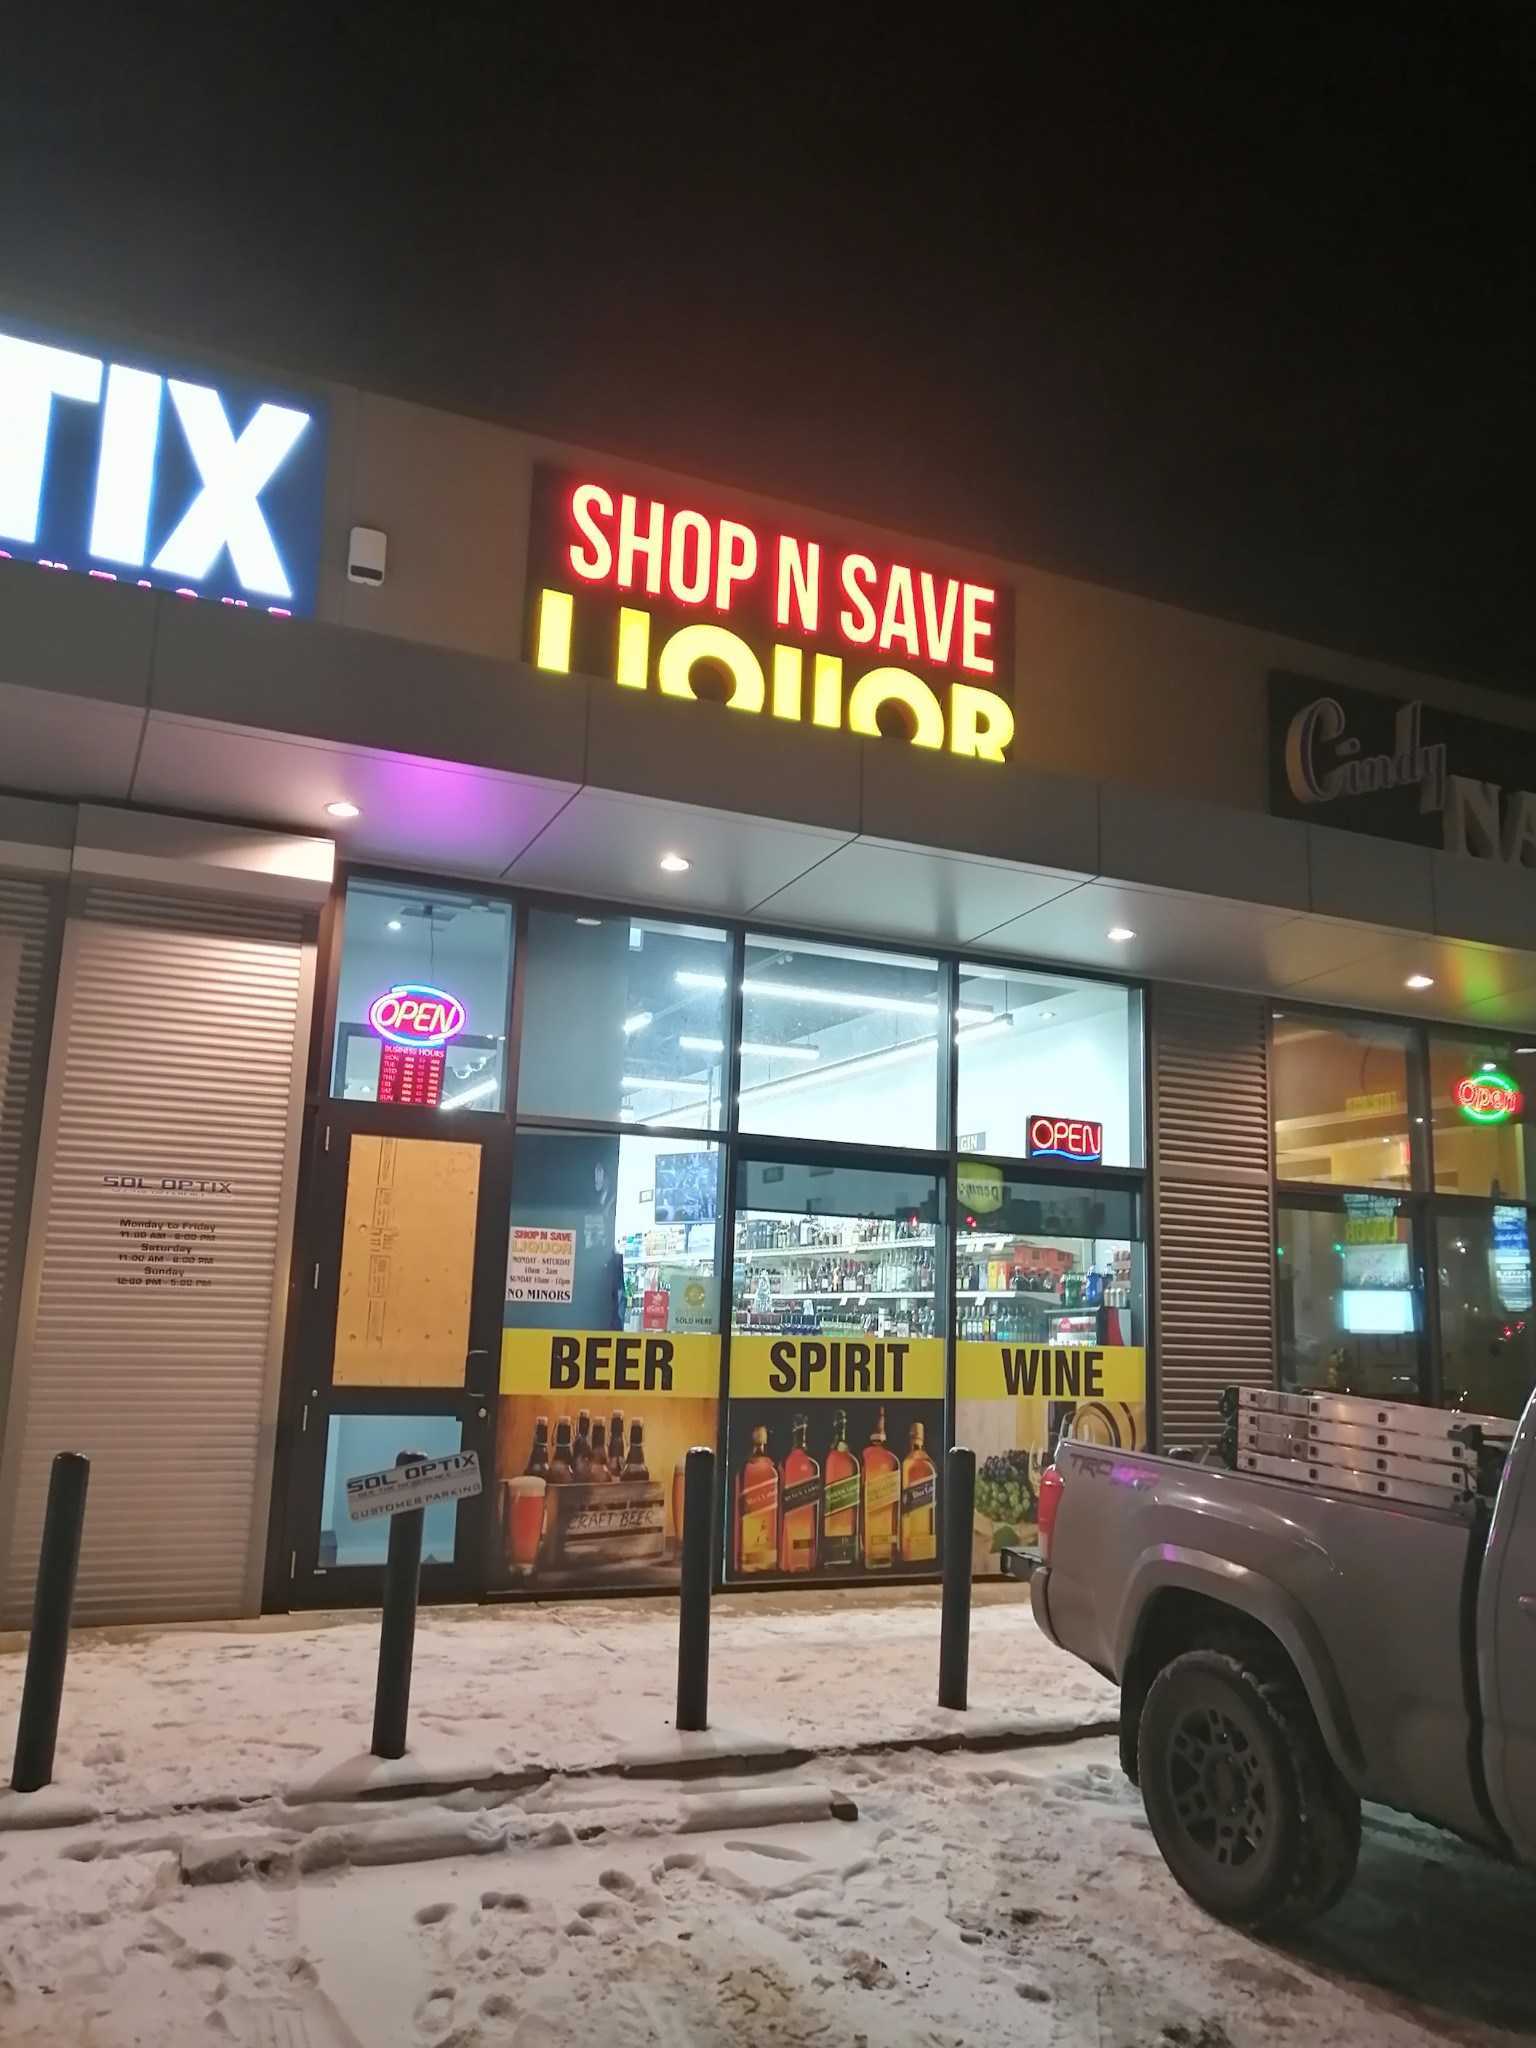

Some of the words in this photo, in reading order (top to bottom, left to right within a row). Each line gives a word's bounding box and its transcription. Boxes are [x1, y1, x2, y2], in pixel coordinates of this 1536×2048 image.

[569, 483, 758, 612] SHOP
[776, 534, 821, 632] N
[839, 552, 996, 674] SAVE
[1286, 696, 1447, 814] Cindy
[376, 998, 457, 1033] OPEN
[419, 1048, 445, 1058] HOURS
[1458, 1078, 1519, 1113] Open
[1031, 1118, 1103, 1155] OPEN
[103, 1176, 157, 1190] SOL
[161, 1178, 233, 1194] OPTIX
[119, 1219, 164, 1231] Monday
[167, 1221, 179, 1229] to
[182, 1222, 216, 1233] Friday
[150, 1232, 166, 1240] AM
[514, 1230, 539, 1240] SHOP
[540, 1231, 547, 1240] N
[550, 1232, 573, 1242] SAVE
[140, 1243, 193, 1254] Saturday
[511, 1241, 573, 1254] LIQUOR
[147, 1255, 165, 1263] AM
[513, 1256, 536, 1264] MONDAY
[143, 1266, 185, 1278] Sunday
[510, 1275, 532, 1283] SUNDAY
[145, 1278, 162, 1286] PM
[508, 1288, 524, 1299] NO
[527, 1289, 571, 1301] MINORS
[549, 1336, 675, 1391] BEER
[769, 1341, 910, 1393] SPIRIT
[1001, 1348, 1105, 1398] WINE
[346, 1473, 398, 1494] SOL
[405, 1454, 476, 1480] OPTIX
[1069, 1453, 1114, 1479] TRD
[351, 1496, 423, 1521] CUSTOMER
[426, 1482, 481, 1503] PARKING
[567, 1510, 617, 1531] CRAFT
[619, 1509, 656, 1528] BEER
